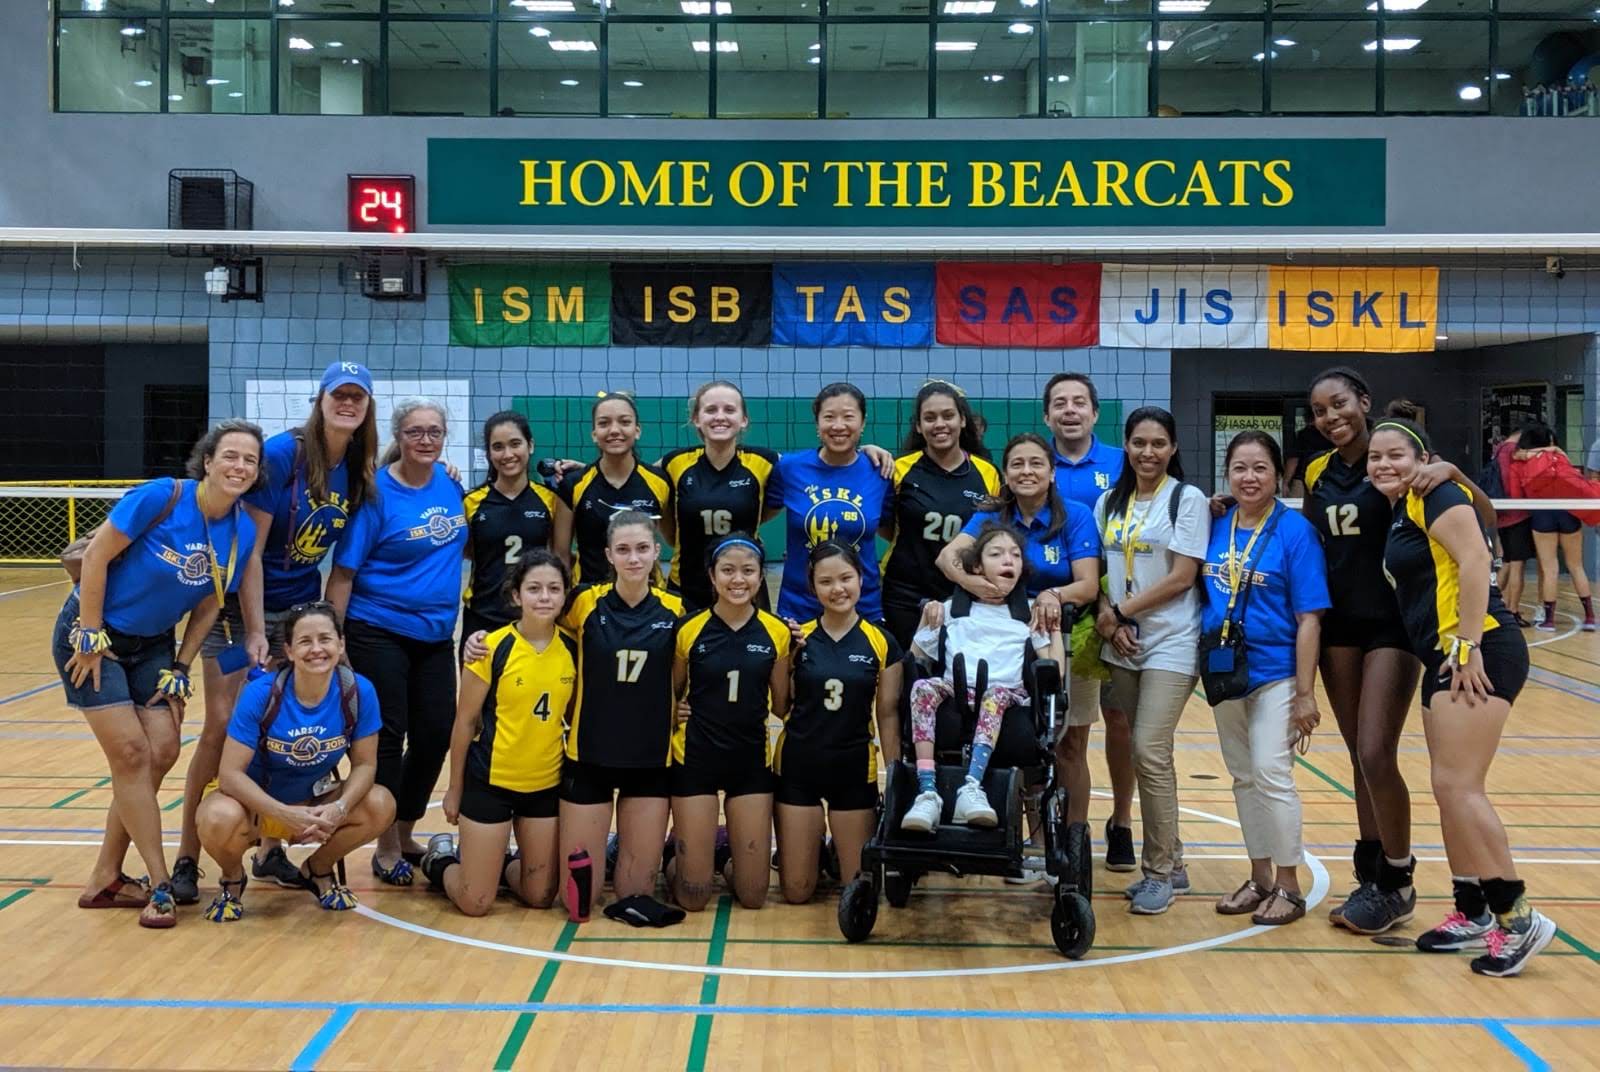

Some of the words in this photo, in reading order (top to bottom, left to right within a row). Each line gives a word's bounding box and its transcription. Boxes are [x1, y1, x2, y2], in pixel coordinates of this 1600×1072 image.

[520, 160, 713, 207] HOME
[729, 160, 809, 207] OF
[824, 161, 951, 207] THE
[970, 160, 1294, 207] BEARCATS
[361, 188, 402, 222] 24
[474, 286, 584, 324] ISM
[644, 286, 741, 323] ISB
[796, 285, 911, 324] TAS
[959, 285, 1078, 324] SAS
[1134, 288, 1234, 325] JIS
[1278, 290, 1427, 328] ISKL
[342, 361, 359, 375] KC
[809, 487, 863, 507] ISKL
[700, 509, 733, 535] 16
[922, 511, 963, 542] 20
[1326, 503, 1361, 536] 12
[505, 535, 523, 564] 2
[615, 649, 649, 683] 17
[727, 670, 740, 702] 1
[824, 678, 844, 711] 3
[533, 692, 551, 722] 4
[288, 726, 327, 737] VARSITY
